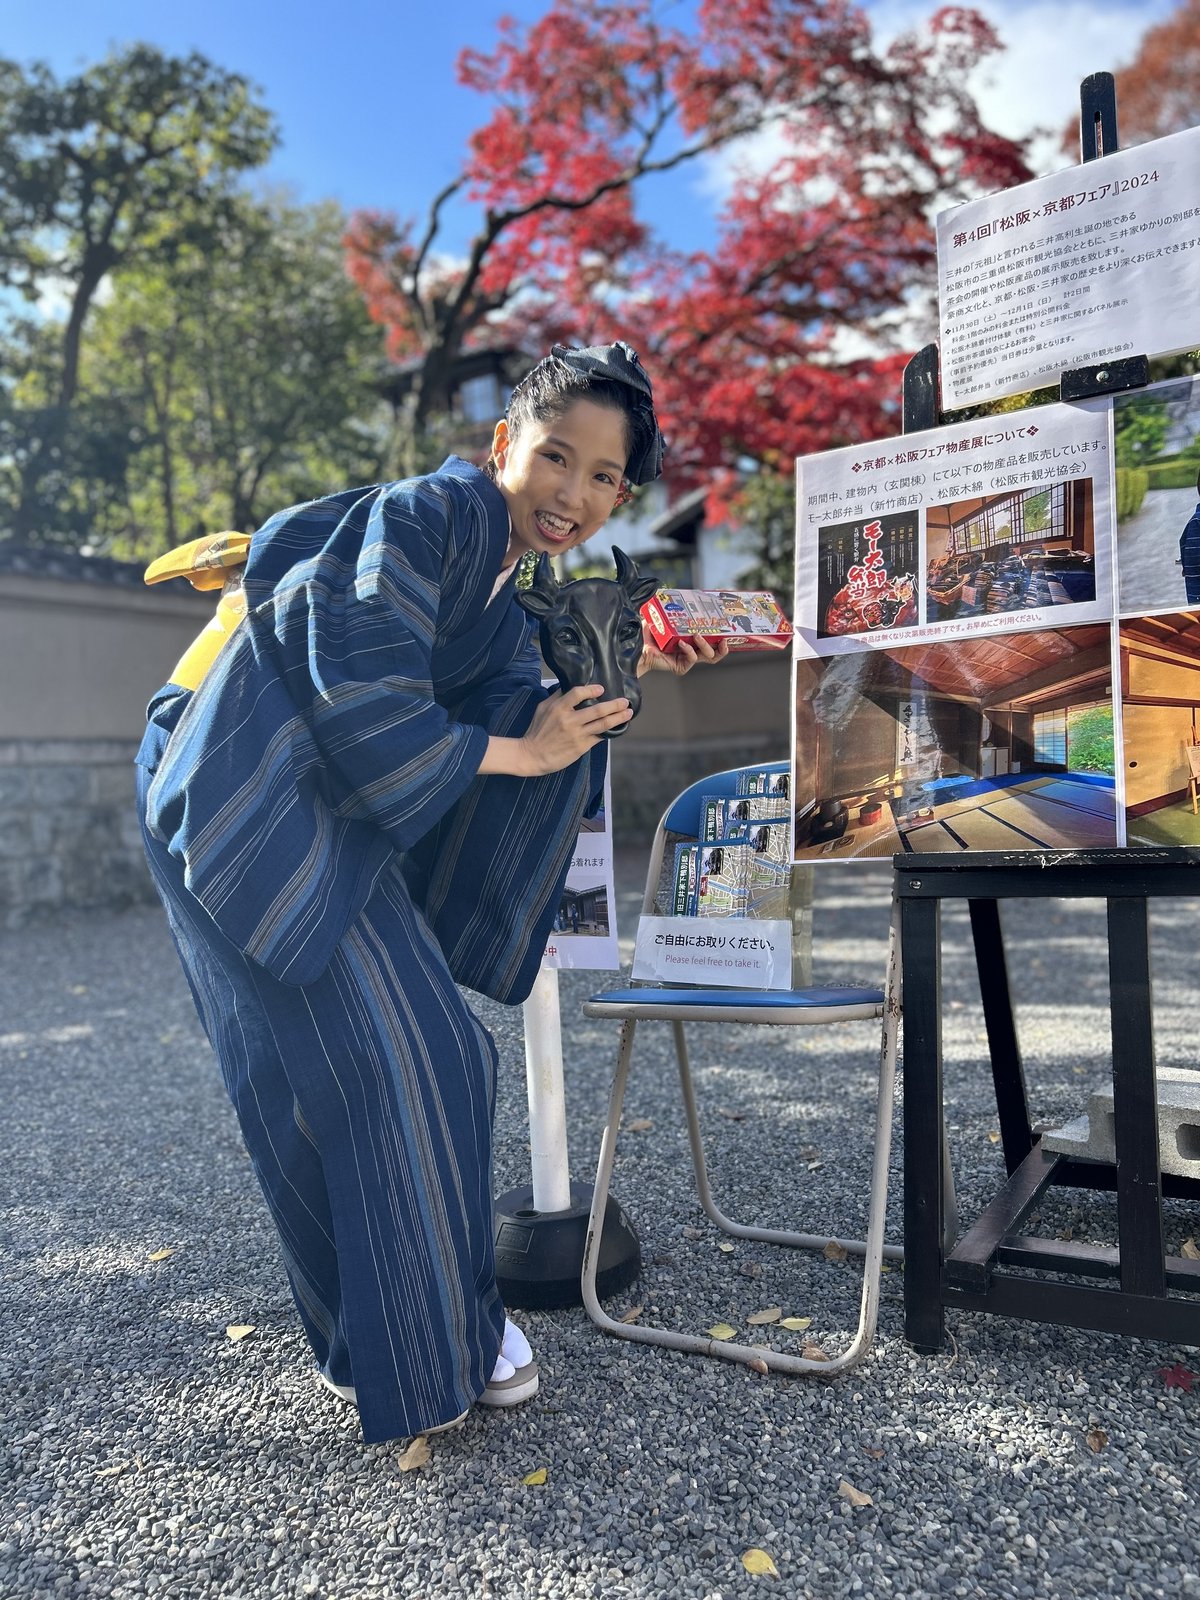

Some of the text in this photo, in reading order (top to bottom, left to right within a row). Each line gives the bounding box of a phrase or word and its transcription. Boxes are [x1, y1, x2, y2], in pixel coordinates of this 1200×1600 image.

[953, 170, 1160, 249] 第4回『松阪×京都フェア』2024
[945, 211, 1137, 280] 三井の「元祖」と言われる三井高利生誕の地である
[807, 440, 1107, 505] 期間中、建物内（玄関棟）にて以下の物産品を販売しています。
[654, 933, 776, 952] ご自由にお取りください。
[665, 954, 761, 969] Please feel free to take it.
